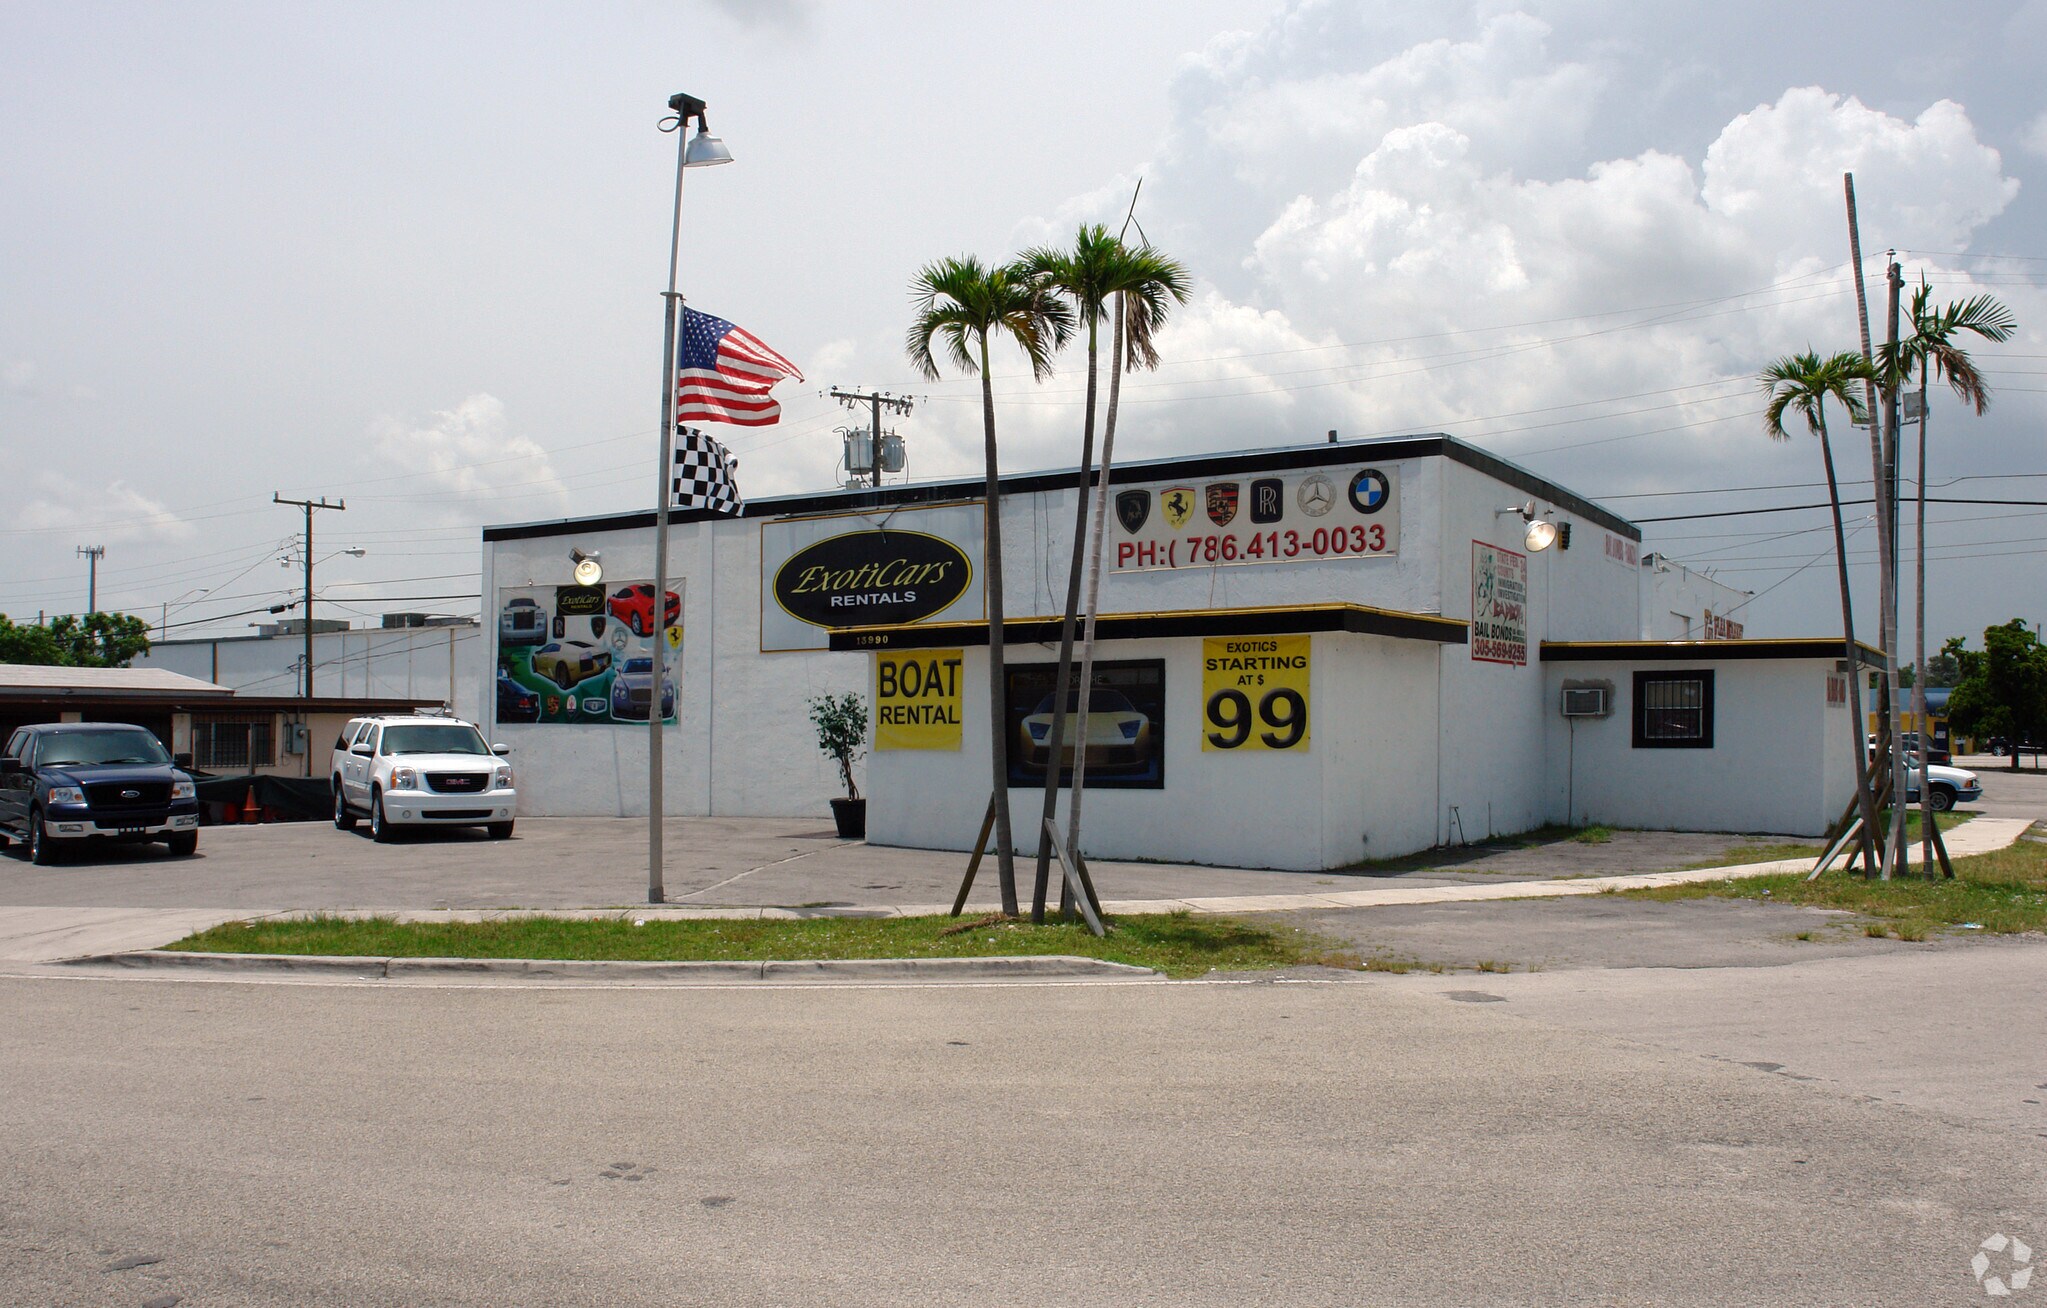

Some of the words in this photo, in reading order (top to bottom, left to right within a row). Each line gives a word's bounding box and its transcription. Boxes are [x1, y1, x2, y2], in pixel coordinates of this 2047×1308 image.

[1187, 524, 1386, 563] 786.413-0033
[790, 558, 953, 595] ExotiCars
[830, 590, 917, 607] RENTALS
[1474, 621, 1490, 638] BAIL
[1491, 623, 1513, 641] BONDS
[1226, 641, 1278, 653] EXOTICS
[1206, 656, 1307, 671] STARTING
[879, 658, 962, 698] BOAT
[1237, 674, 1254, 686] AT
[879, 704, 961, 725] RENTAL
[1206, 687, 1307, 749] 99
